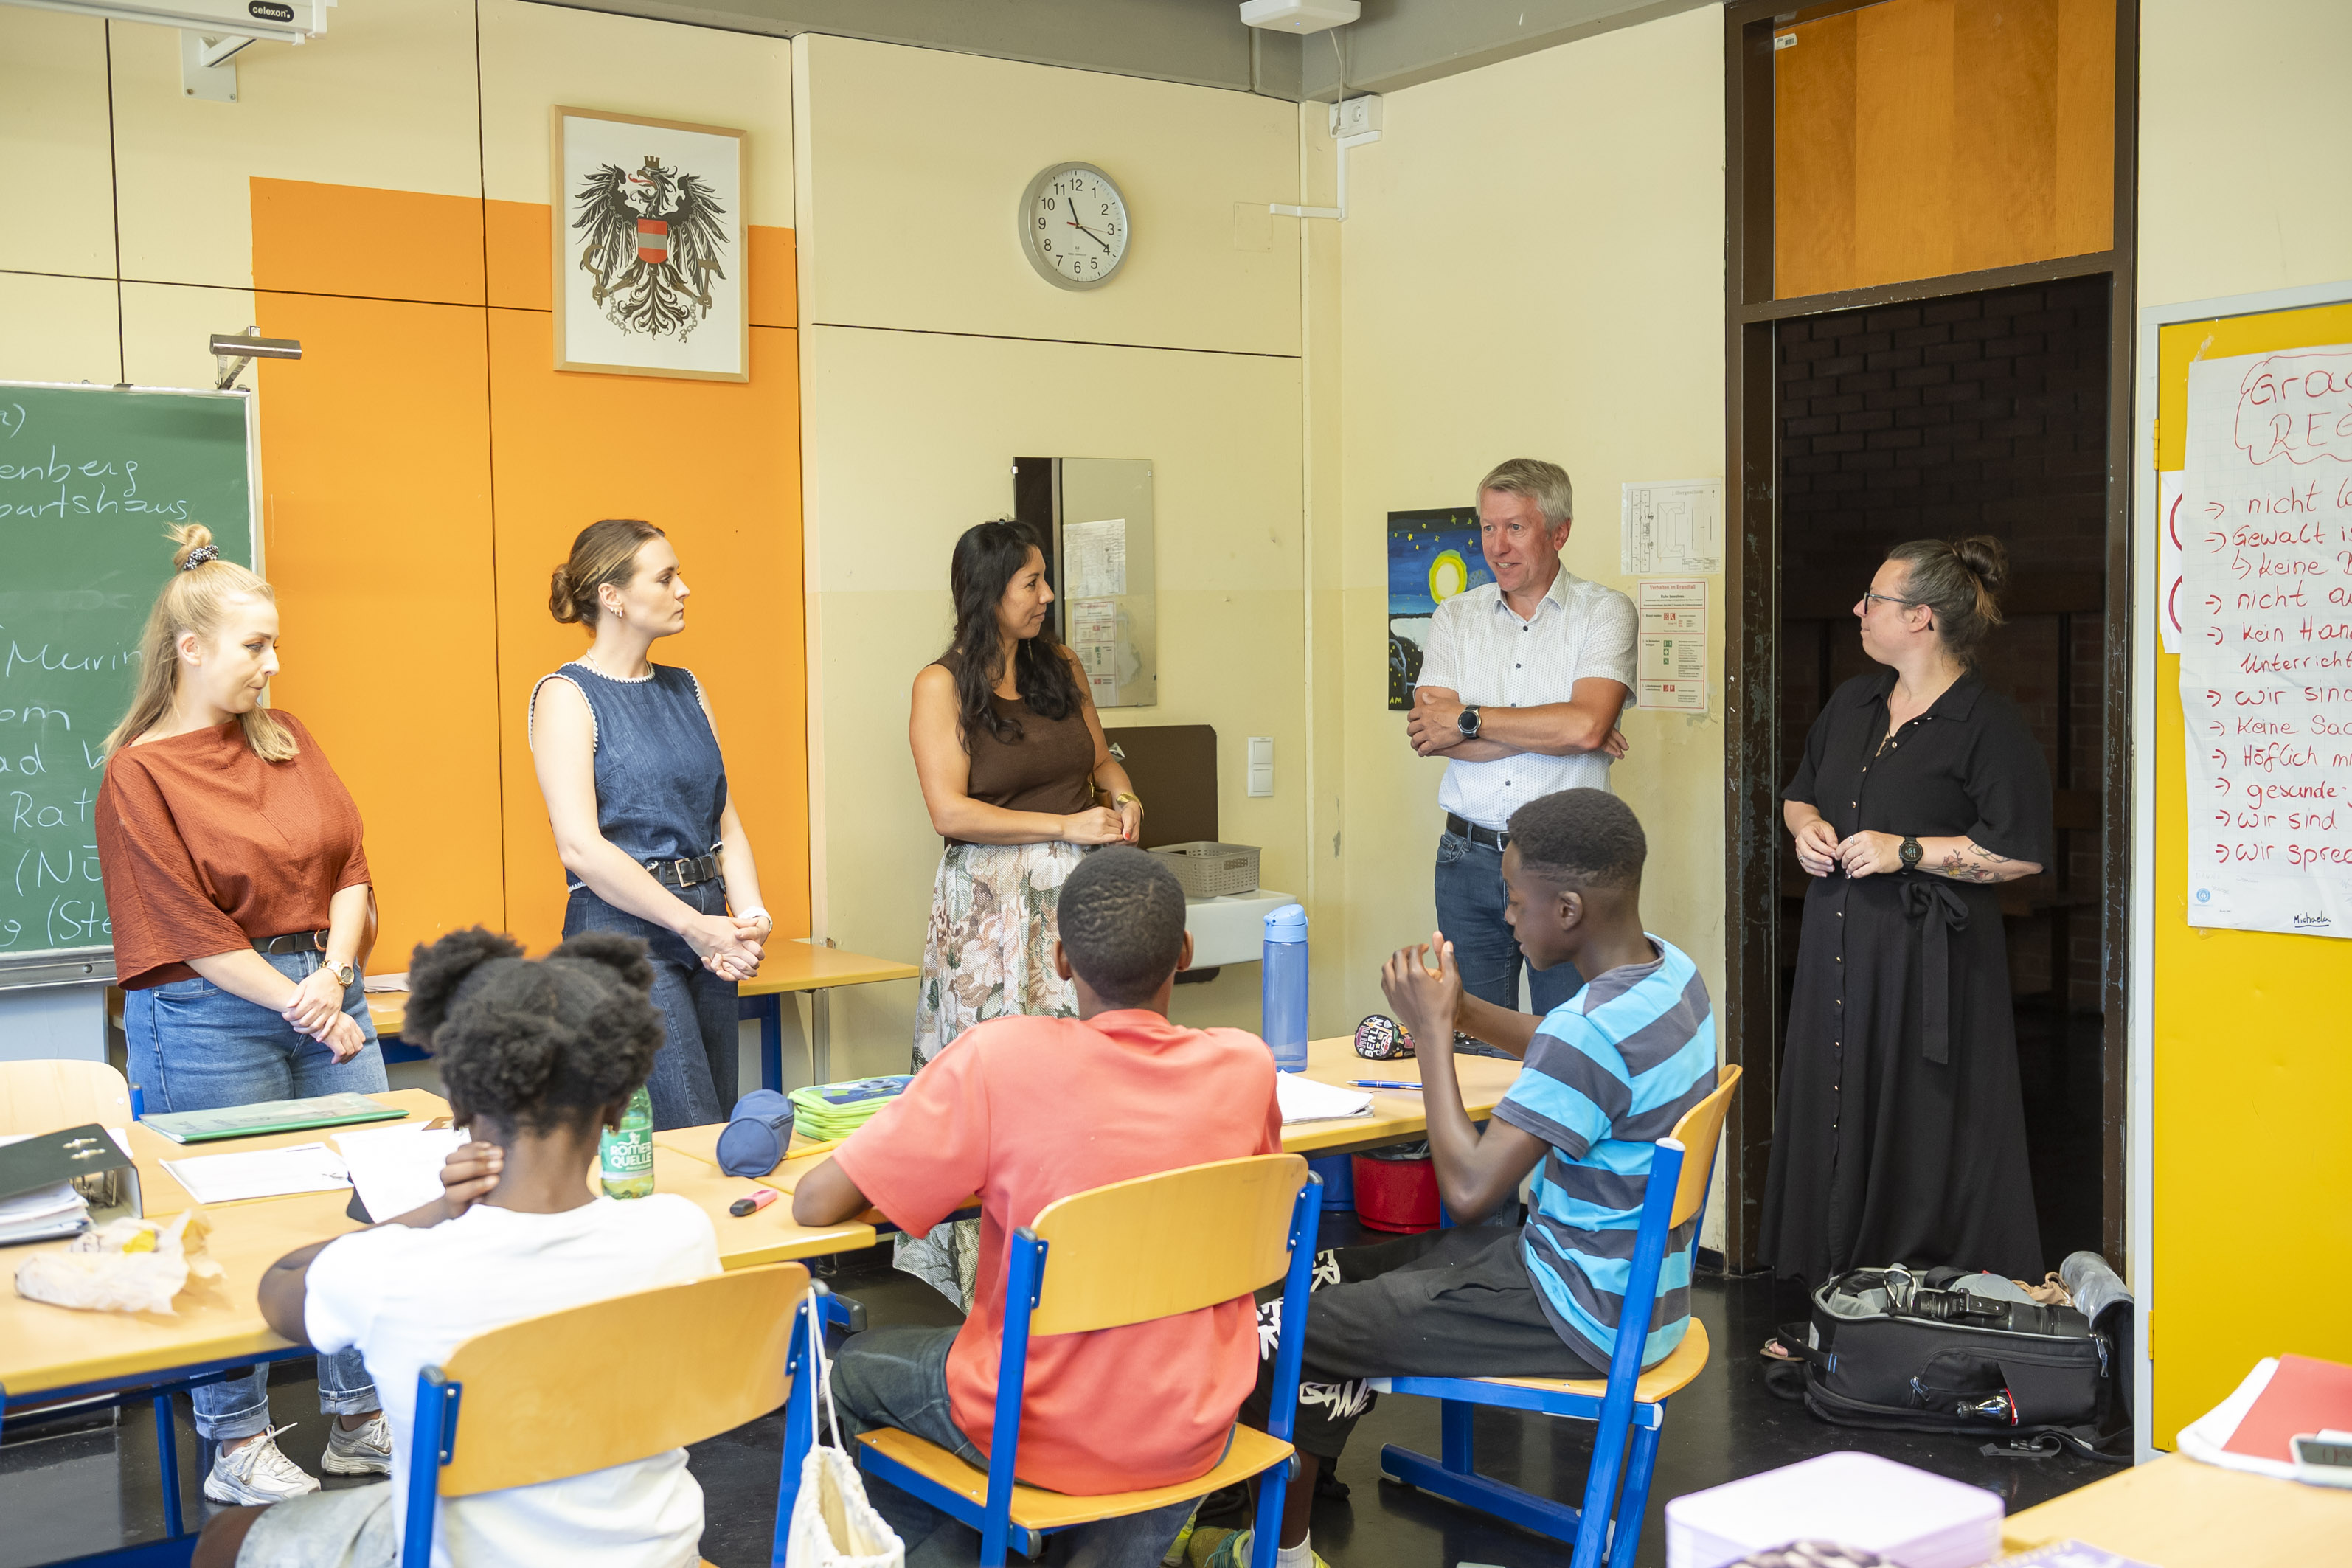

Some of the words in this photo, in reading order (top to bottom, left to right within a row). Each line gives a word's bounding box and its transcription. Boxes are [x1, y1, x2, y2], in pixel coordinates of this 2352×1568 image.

[1053, 183, 1065, 195] 11
[1069, 178, 1083, 191] 12
[1092, 186, 1097, 198] 1
[1041, 198, 1055, 211] 10
[1101, 203, 1109, 215] 2
[1038, 217, 1046, 229] 9
[1107, 223, 1114, 235] 3
[1044, 238, 1052, 251] 8
[1103, 244, 1111, 256] 4
[1055, 254, 1064, 267] 7
[1090, 257, 1097, 269] 5
[1074, 261, 1081, 274] 6
[2248, 479, 2323, 514] nicht
[2232, 521, 2327, 547] Gewalt
[2238, 580, 2308, 610] nicht
[2300, 615, 2352, 642] Han
[2288, 808, 2338, 830] sind
[2293, 910, 2331, 924] Michaela
[611, 1151, 652, 1169] QUELLE
